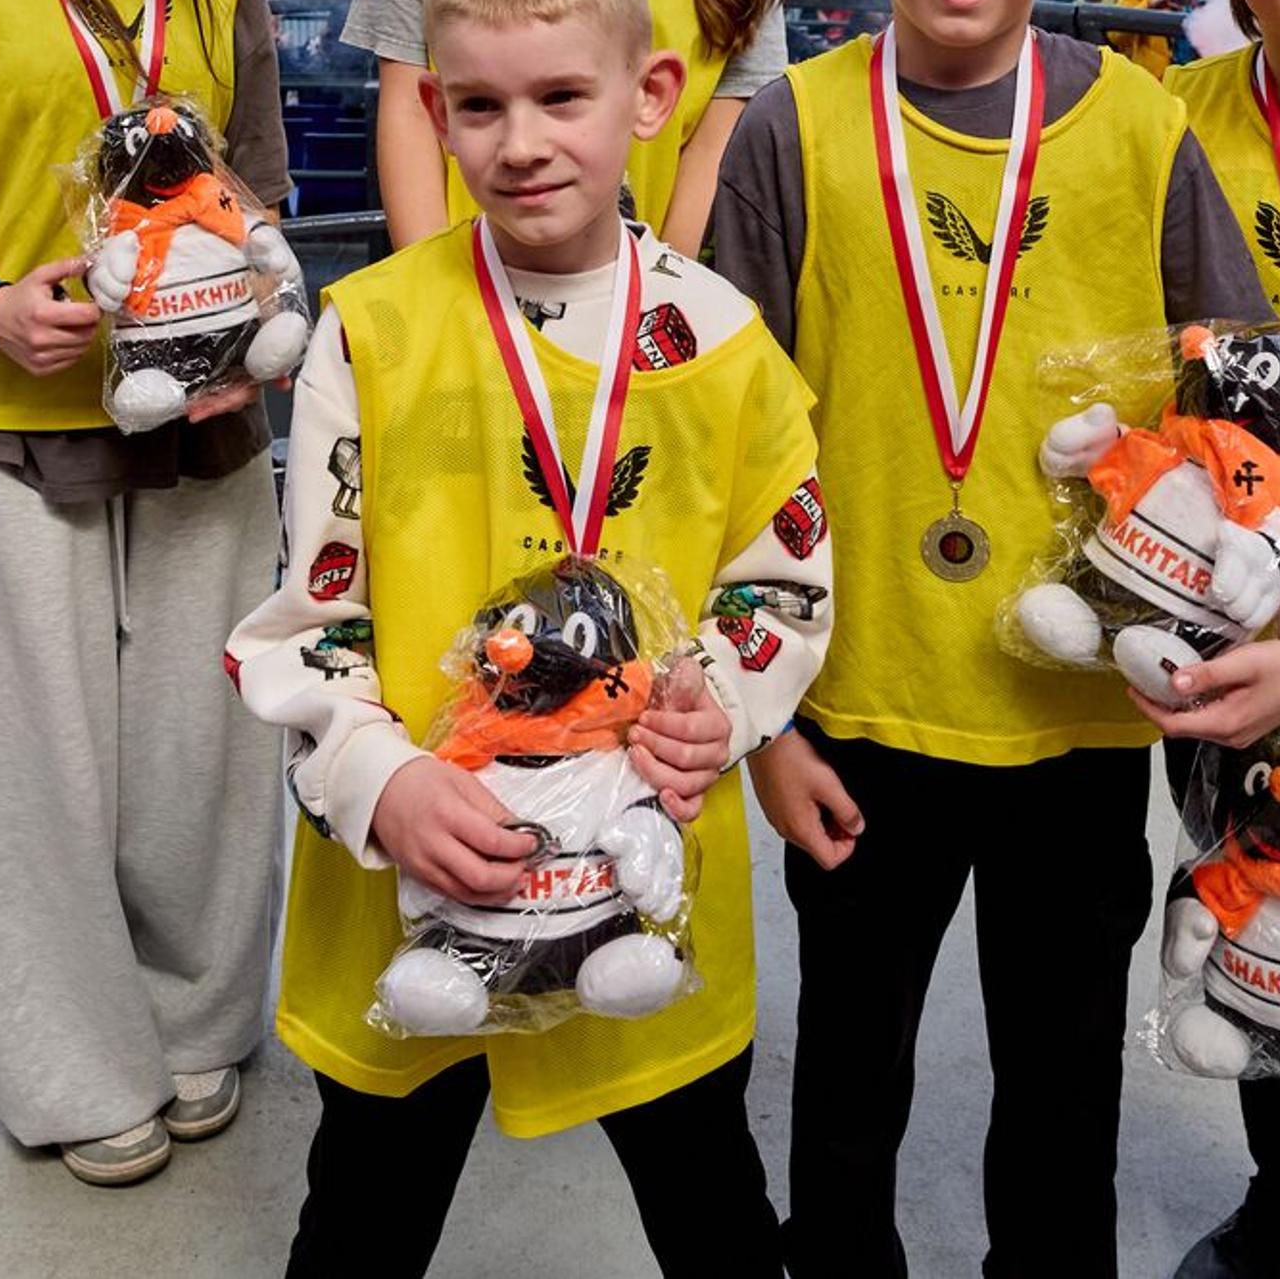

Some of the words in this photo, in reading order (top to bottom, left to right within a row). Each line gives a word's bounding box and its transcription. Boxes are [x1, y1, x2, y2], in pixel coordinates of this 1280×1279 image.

[941, 285, 1031, 299] CASRE
[523, 536, 624, 563] CASRE
[1102, 521, 1212, 596] AKHTAR
[517, 861, 613, 901] HTAR
